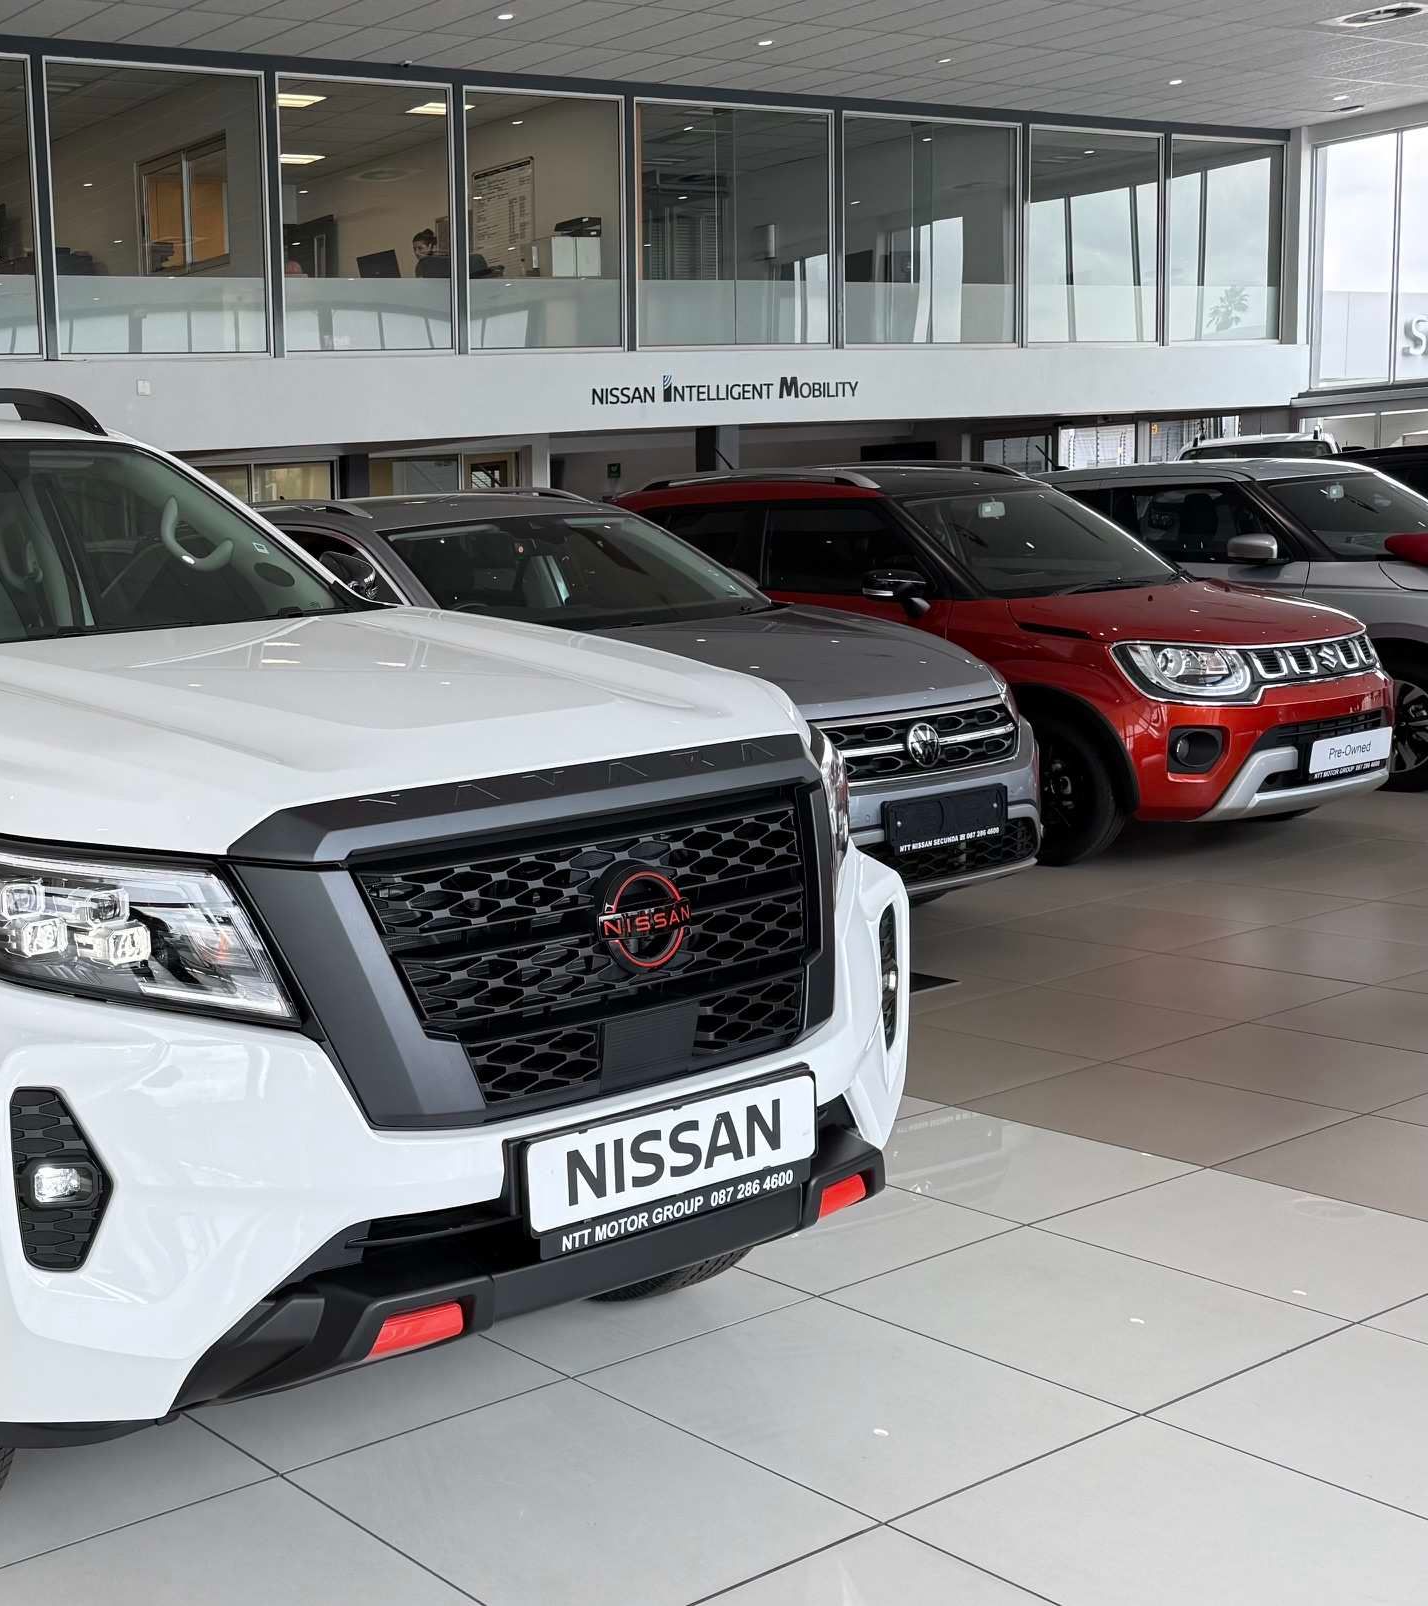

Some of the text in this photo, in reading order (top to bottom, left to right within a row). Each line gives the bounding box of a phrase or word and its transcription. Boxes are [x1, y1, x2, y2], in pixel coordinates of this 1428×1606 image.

[591, 386, 655, 405] NISSAN
[1329, 741, 1371, 760] Pre-Owned
[1314, 771, 1323, 779] NTT
[1323, 769, 1339, 778] MOTOR
[1339, 766, 1355, 774] GROUP
[899, 844, 911, 853] NTT
[911, 840, 933, 850] NISSAN
[933, 835, 958, 846] SECUNDA
[966, 832, 976, 840] 087
[603, 904, 691, 936] NISSAN
[566, 1098, 781, 1207] NISSAN
[562, 1169, 794, 1252] NTT MOTOR GROUP 087 286 4600
